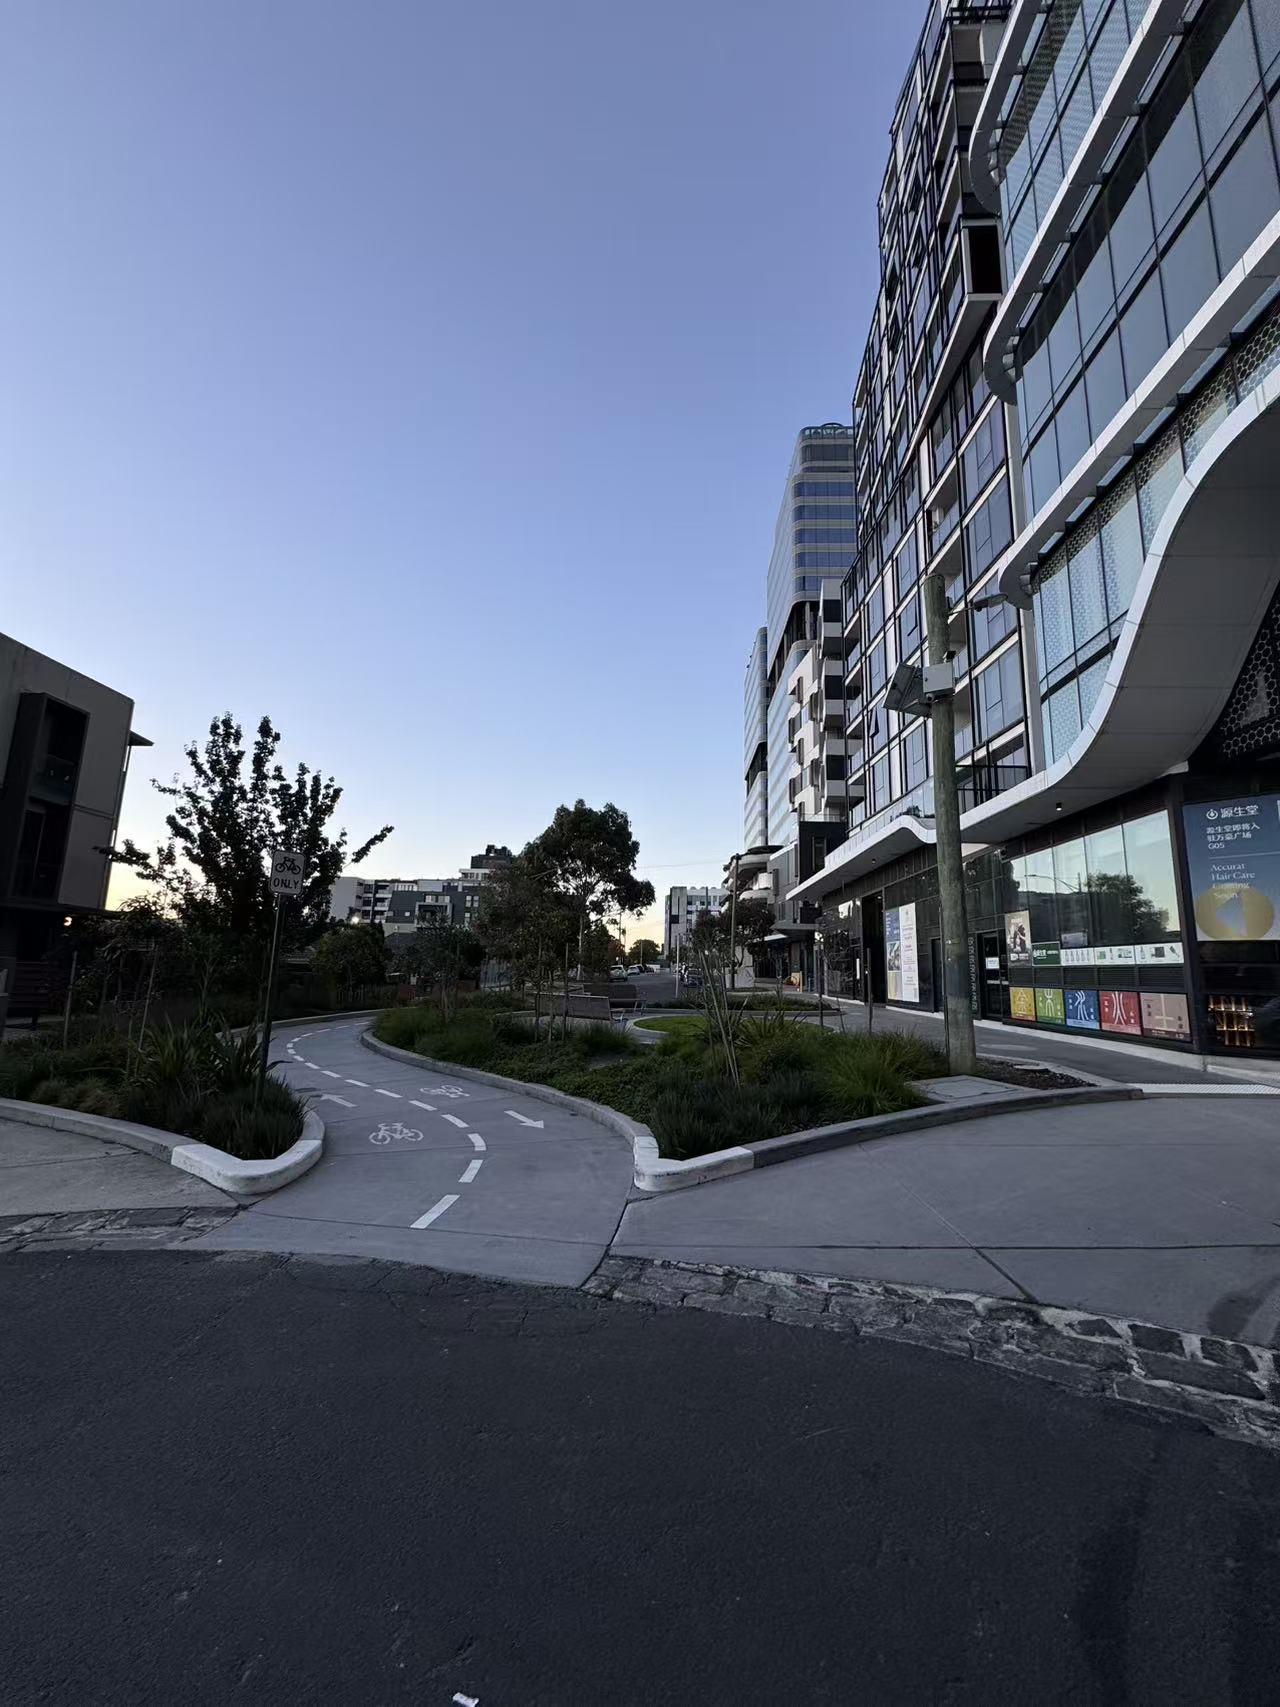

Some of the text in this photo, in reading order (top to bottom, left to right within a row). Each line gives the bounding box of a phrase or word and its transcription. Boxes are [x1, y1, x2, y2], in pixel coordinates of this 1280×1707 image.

[1220, 805, 1259, 818] 源生堂
[1211, 871, 1256, 881] Hair Care
[274, 877, 300, 889] ONLY
